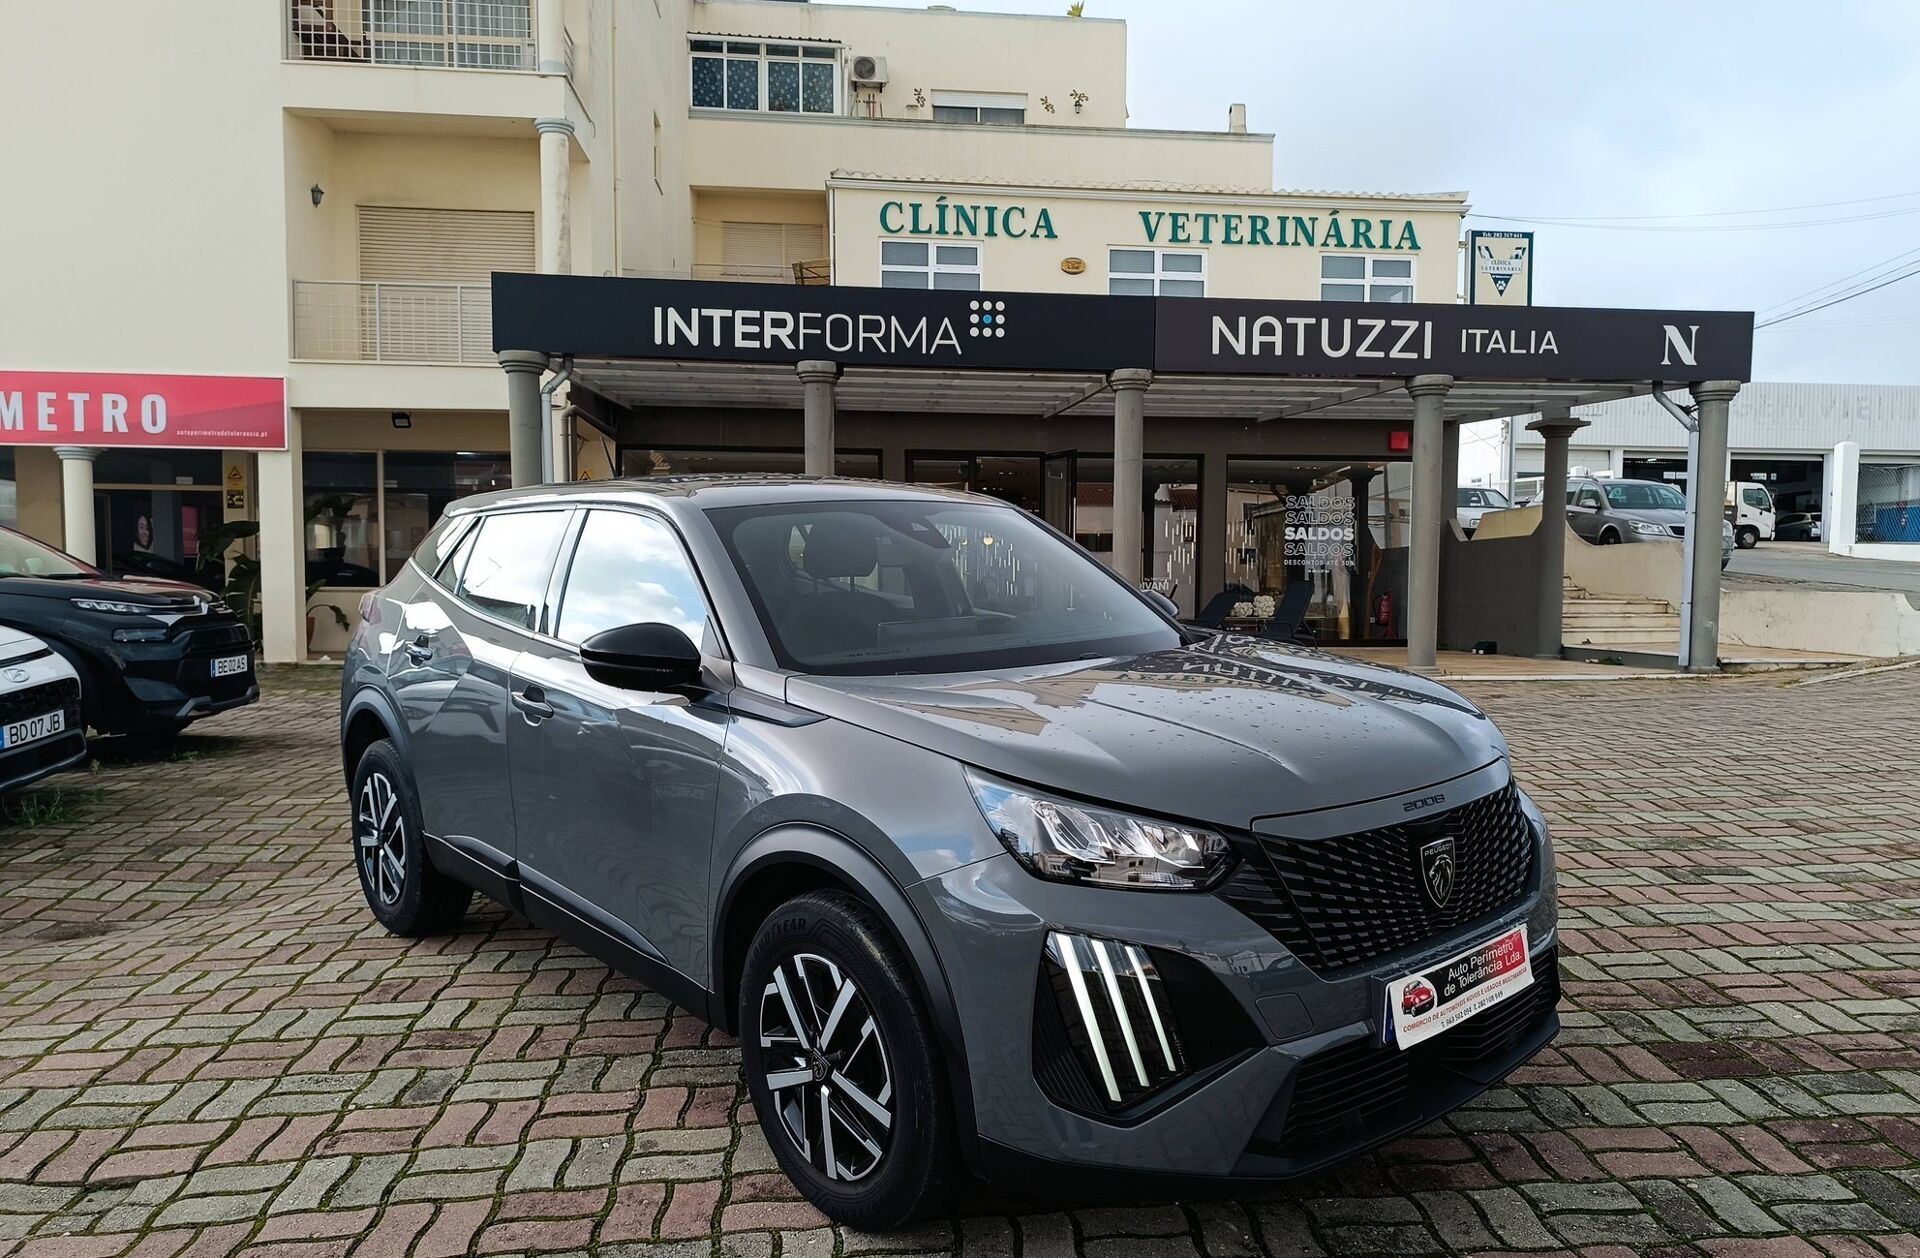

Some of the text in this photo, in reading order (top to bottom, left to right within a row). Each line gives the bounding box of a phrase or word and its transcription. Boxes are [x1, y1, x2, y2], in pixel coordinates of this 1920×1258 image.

[879, 195, 1421, 250] CLÍNICA VETERINÁRIA
[654, 306, 962, 355] INTERFORMA
[1212, 315, 1559, 359] NATUZZI ITALIA
[1660, 324, 1700, 366] N
[0, 391, 168, 434] METRO
[1285, 495, 1356, 510] SALDOS
[1284, 511, 1355, 525] SALDOS
[1284, 527, 1355, 541] SALDOS
[1284, 542, 1354, 557] SALDOS
[1403, 794, 1446, 812] 2008
[1424, 843, 1452, 857] PEUGEOT
[1444, 952, 1523, 997] de Tolerância Lda.
[1448, 963, 1469, 981] Auto
[1433, 1013, 1439, 1021] DE
[1485, 979, 1502, 994] USADOS
